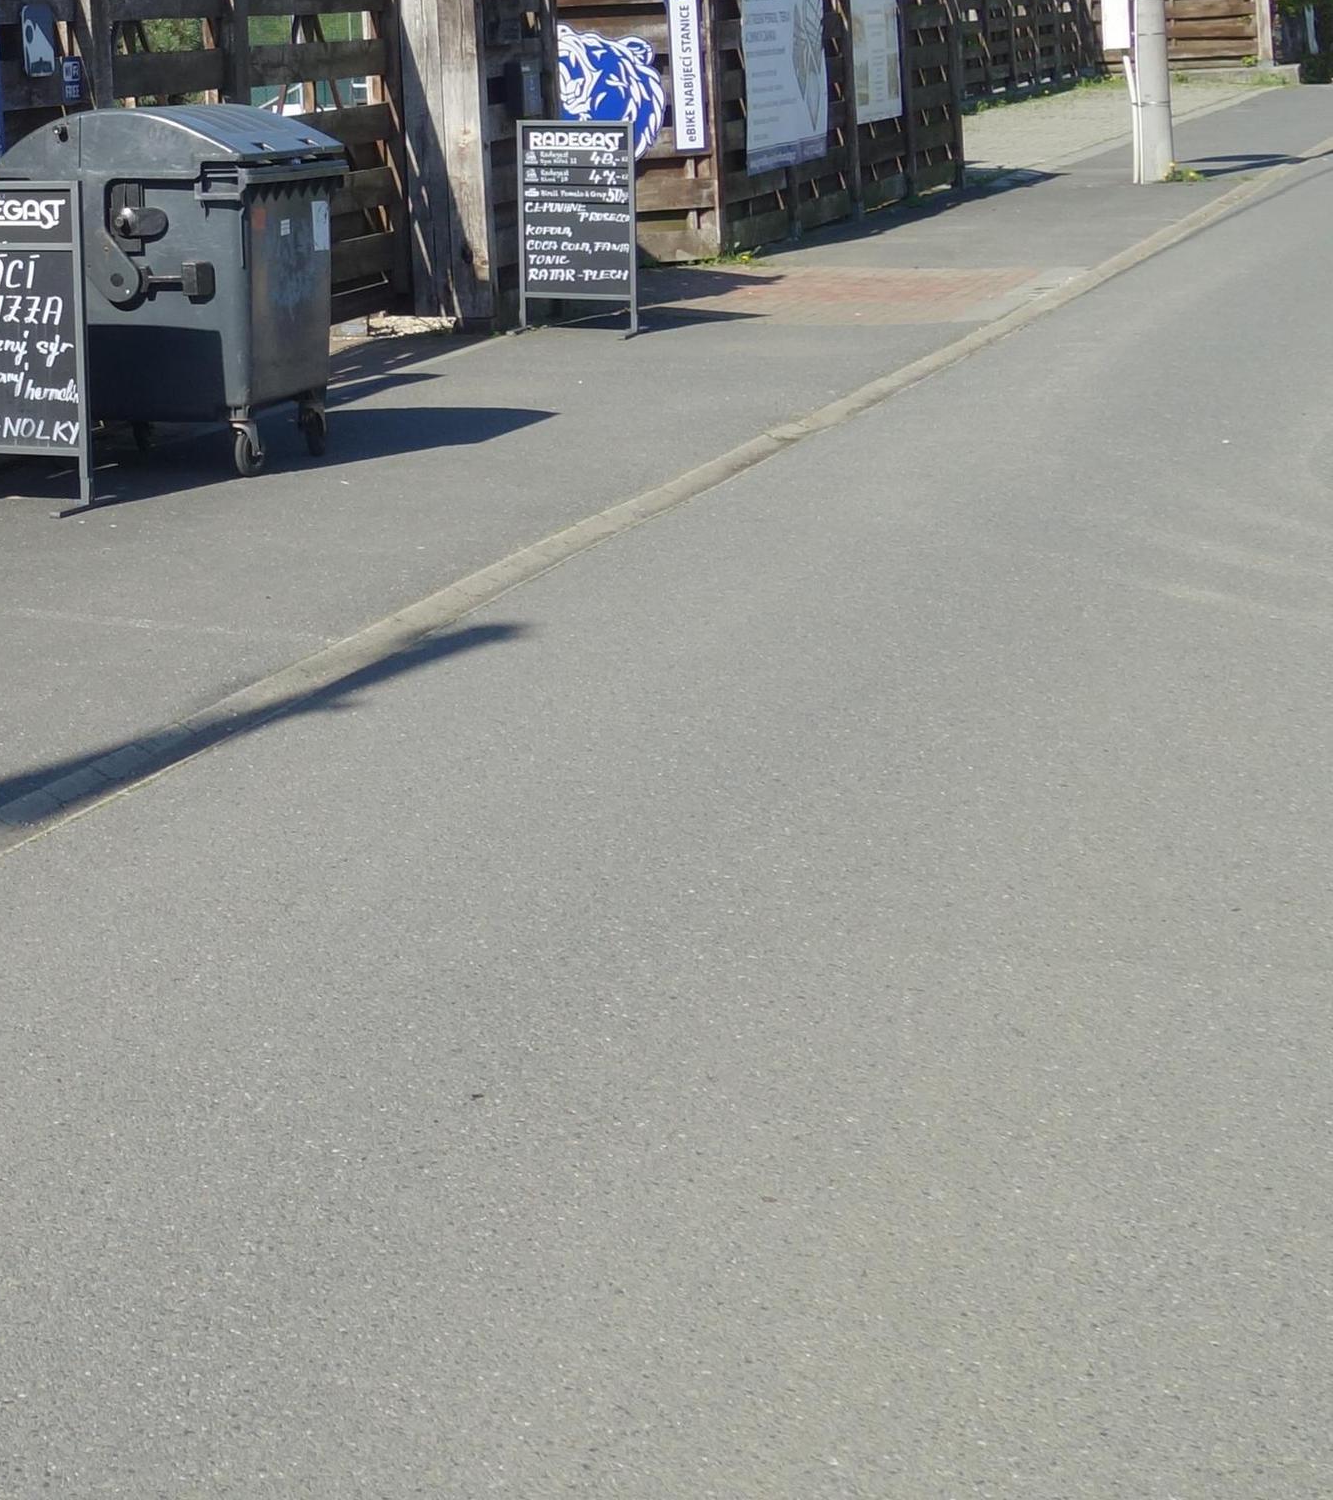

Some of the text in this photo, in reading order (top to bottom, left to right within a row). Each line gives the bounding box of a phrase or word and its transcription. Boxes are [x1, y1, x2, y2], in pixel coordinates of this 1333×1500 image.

[679, 5, 696, 142] eBIKE NABÍJECÍ STANICE
[65, 85, 80, 98] FREE
[529, 131, 624, 152] RADEGAST
[525, 224, 573, 238] KOFOLA,
[526, 240, 558, 251] COCA
[528, 254, 571, 265] TONIC
[36, 334, 75, 368] sýr
